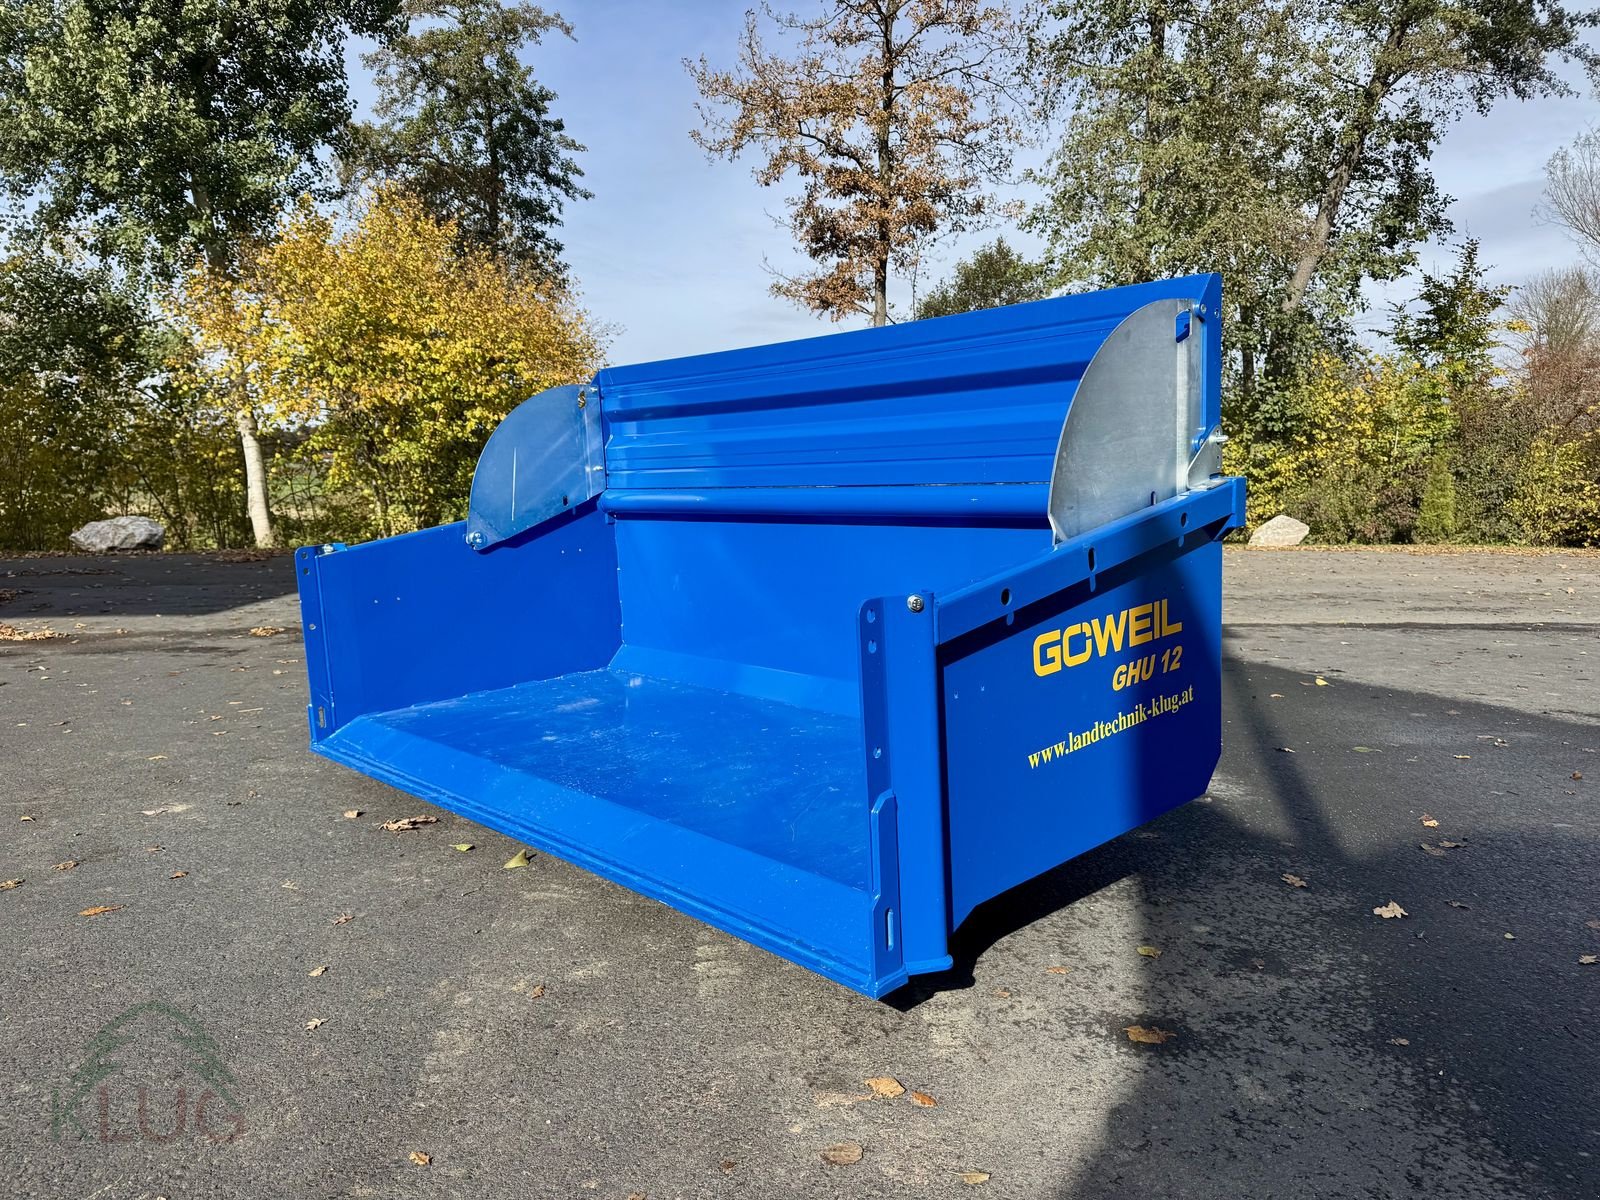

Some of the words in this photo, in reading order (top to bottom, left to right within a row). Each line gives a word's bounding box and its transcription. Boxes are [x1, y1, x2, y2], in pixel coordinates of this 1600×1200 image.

[1112, 655, 1156, 691] GHU
[1161, 645, 1183, 673] 12
[1028, 685, 1194, 769] www.landtechnik-klug.at
